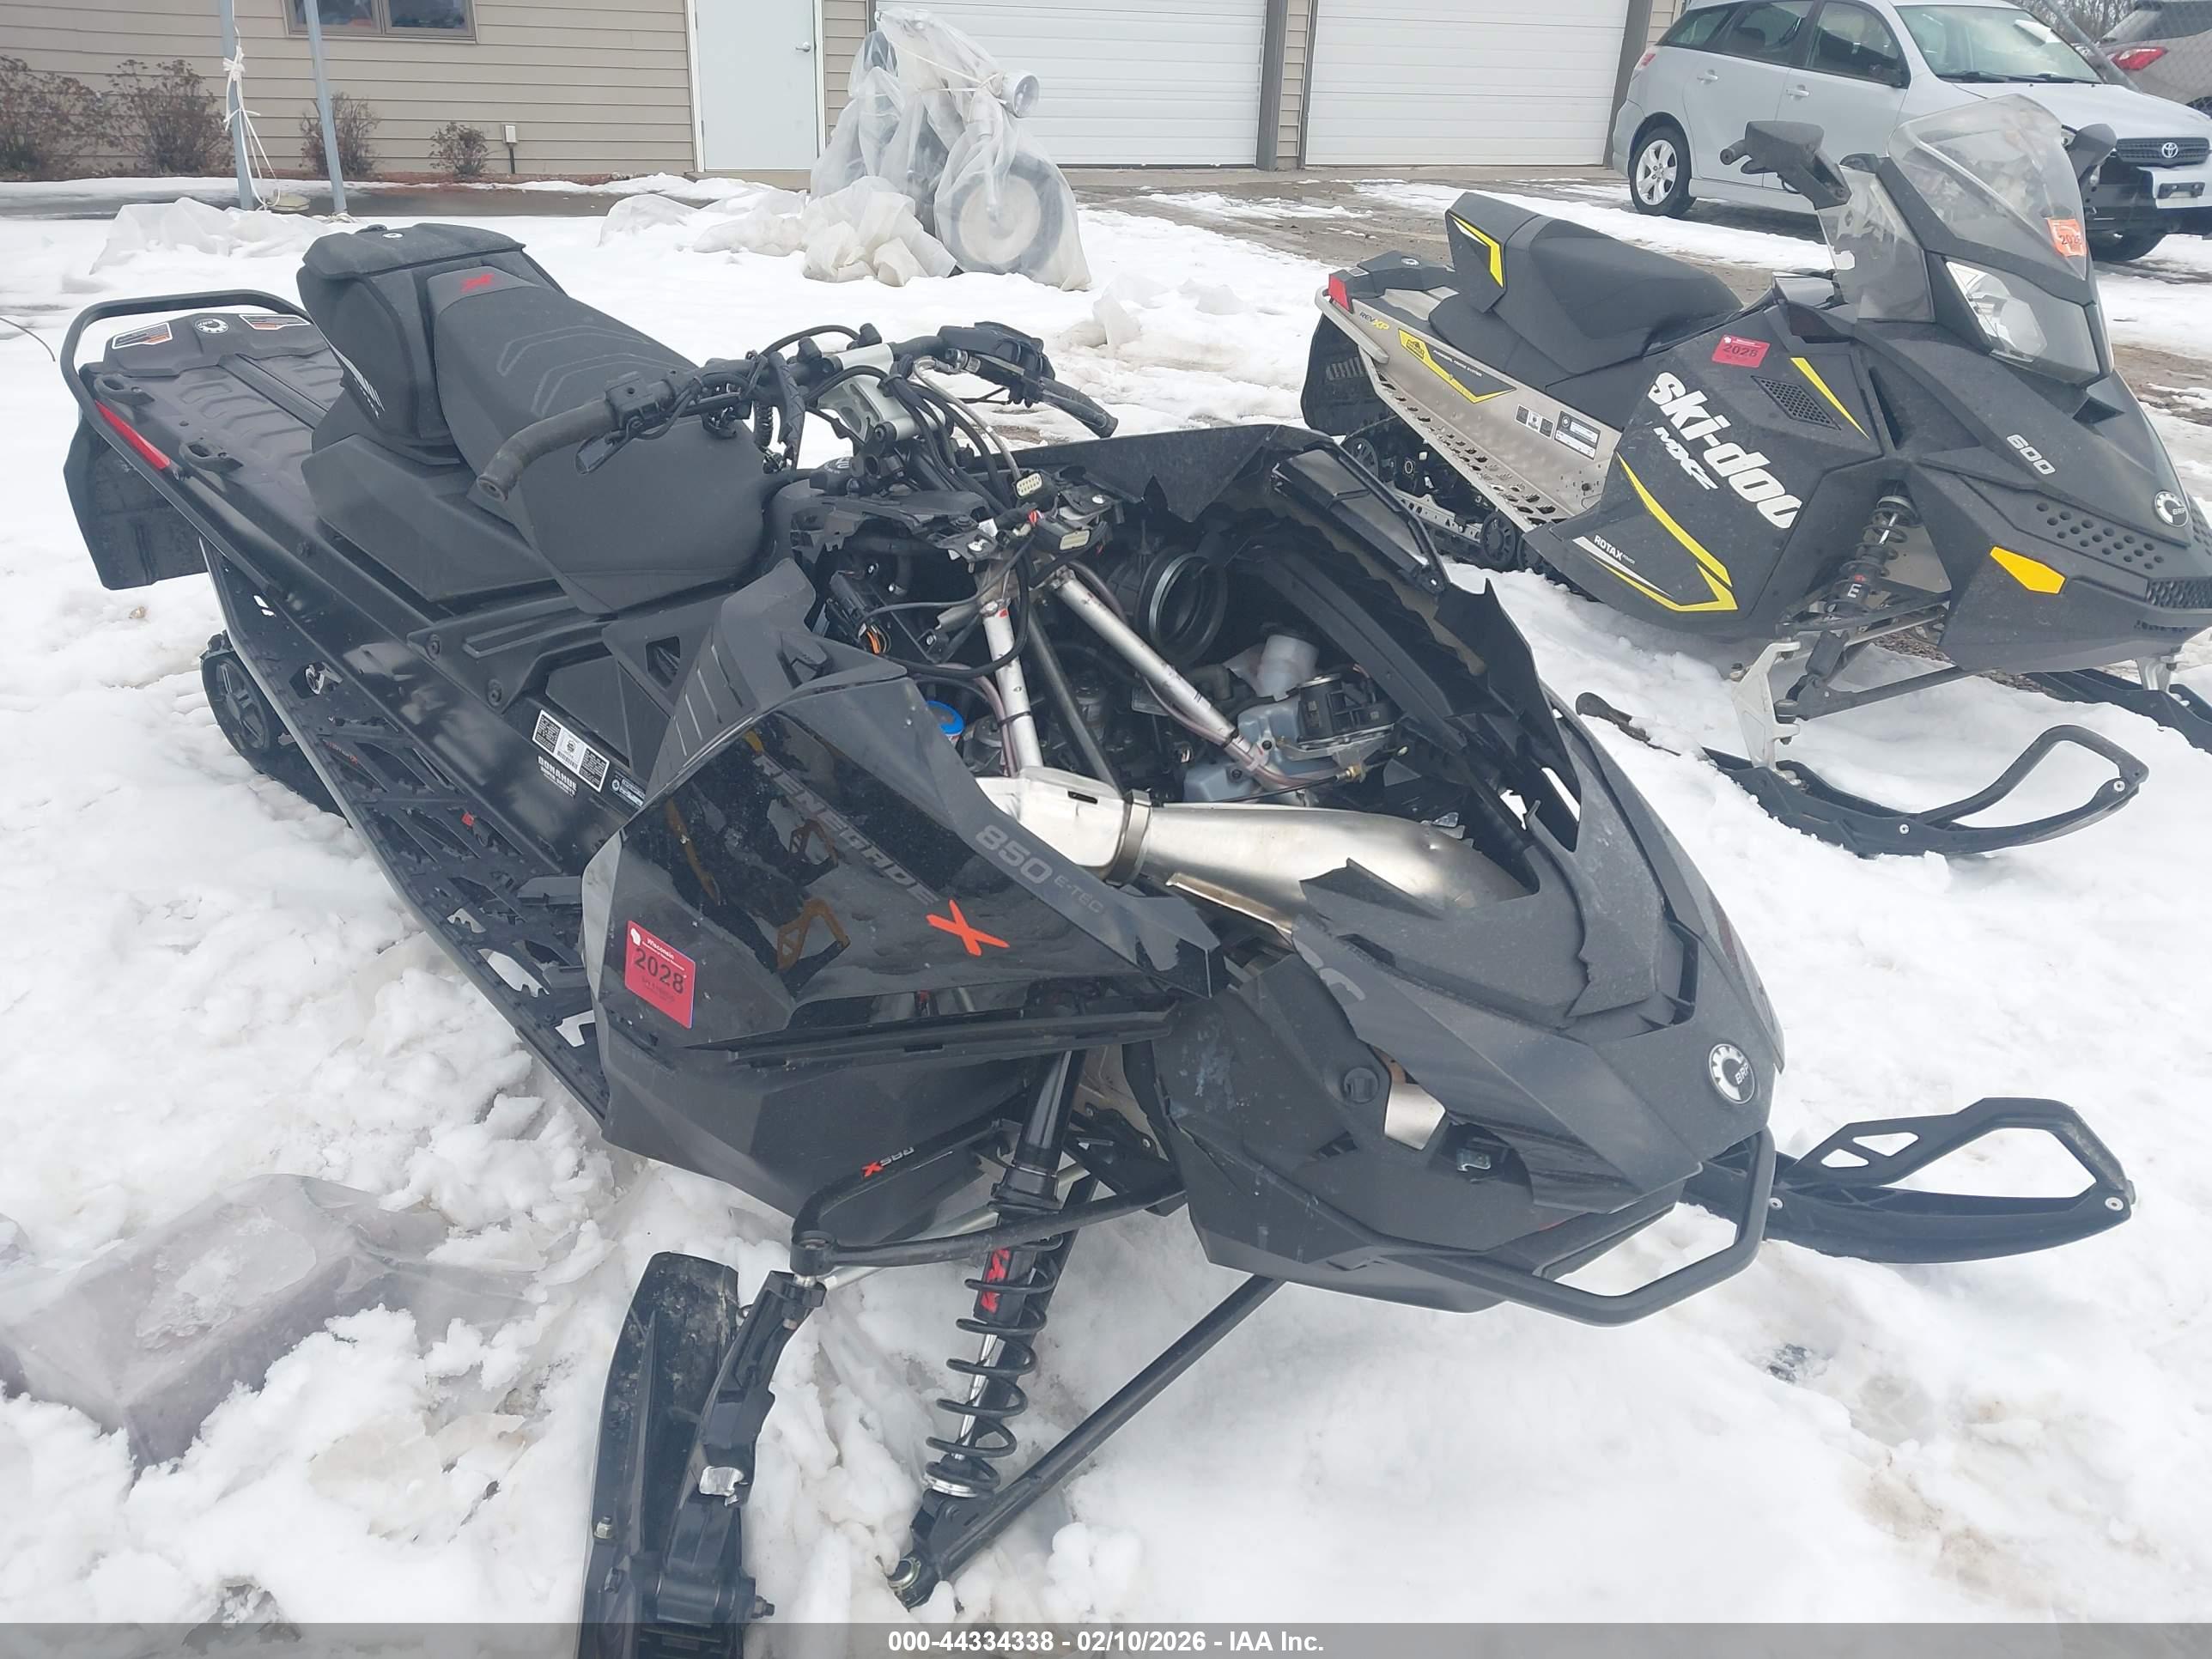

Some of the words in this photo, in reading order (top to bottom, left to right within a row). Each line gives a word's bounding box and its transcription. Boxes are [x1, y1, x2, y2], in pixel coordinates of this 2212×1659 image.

[1723, 343, 1759, 357] 2028
[2006, 434, 2056, 475] 600
[1594, 534, 1623, 561] ROTAX
[752, 755, 939, 906] RENEGADE
[975, 824, 1054, 884] 850
[1054, 874, 1113, 914] E-TEC
[635, 947, 685, 994] 2028
[1735, 1061, 1749, 1085] BRP
